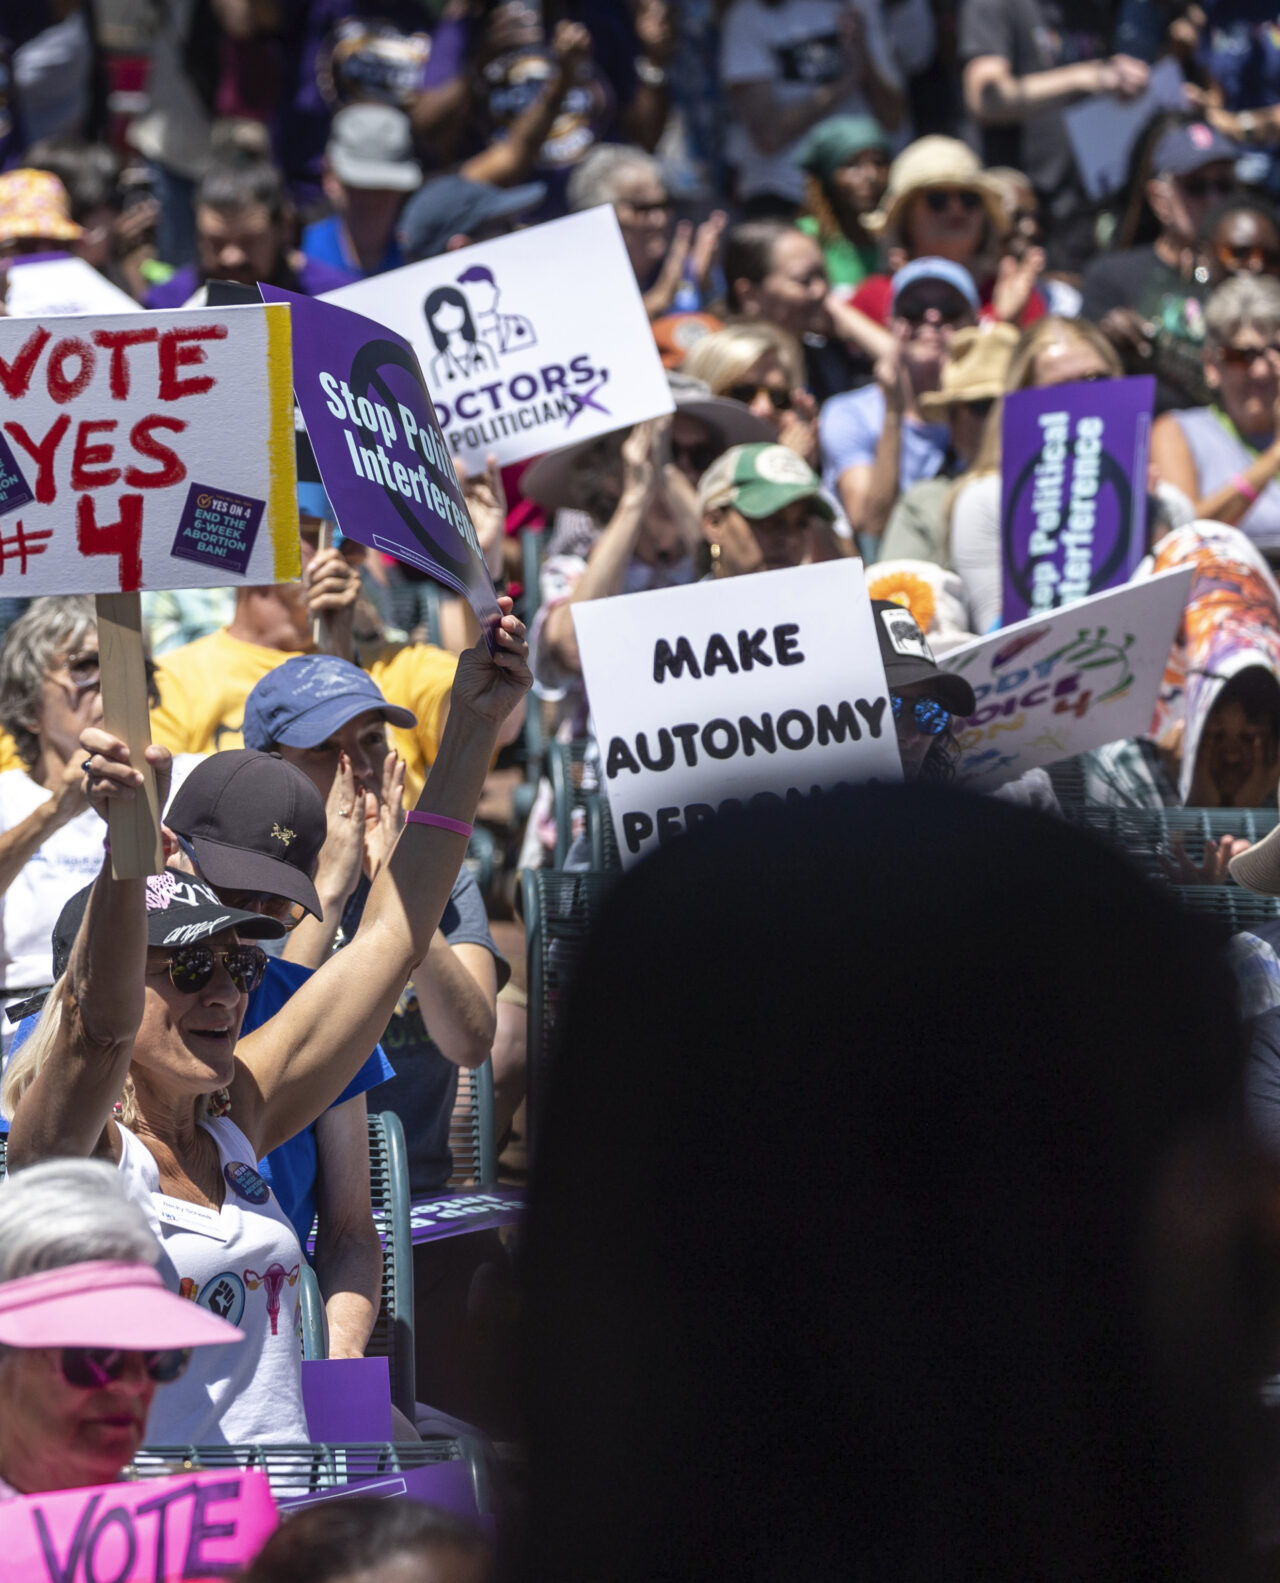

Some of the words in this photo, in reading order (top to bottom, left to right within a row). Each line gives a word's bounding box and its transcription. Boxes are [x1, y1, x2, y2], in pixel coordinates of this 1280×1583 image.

[319, 371, 397, 448] Stop
[4, 413, 190, 504] YES
[1029, 411, 1070, 558] Political
[76, 493, 145, 592] 4
[182, 527, 247, 552] ABORTION
[193, 519, 243, 540] 6-WEEK
[194, 508, 221, 523] END
[223, 515, 247, 530] THE
[211, 499, 229, 513] YES
[229, 504, 244, 517] ON
[243, 508, 252, 519] 4
[196, 541, 228, 557] BAN!
[653, 622, 805, 684] MAKE
[606, 696, 887, 780] AUTONOMY
[32, 1480, 243, 1583] VOTE
